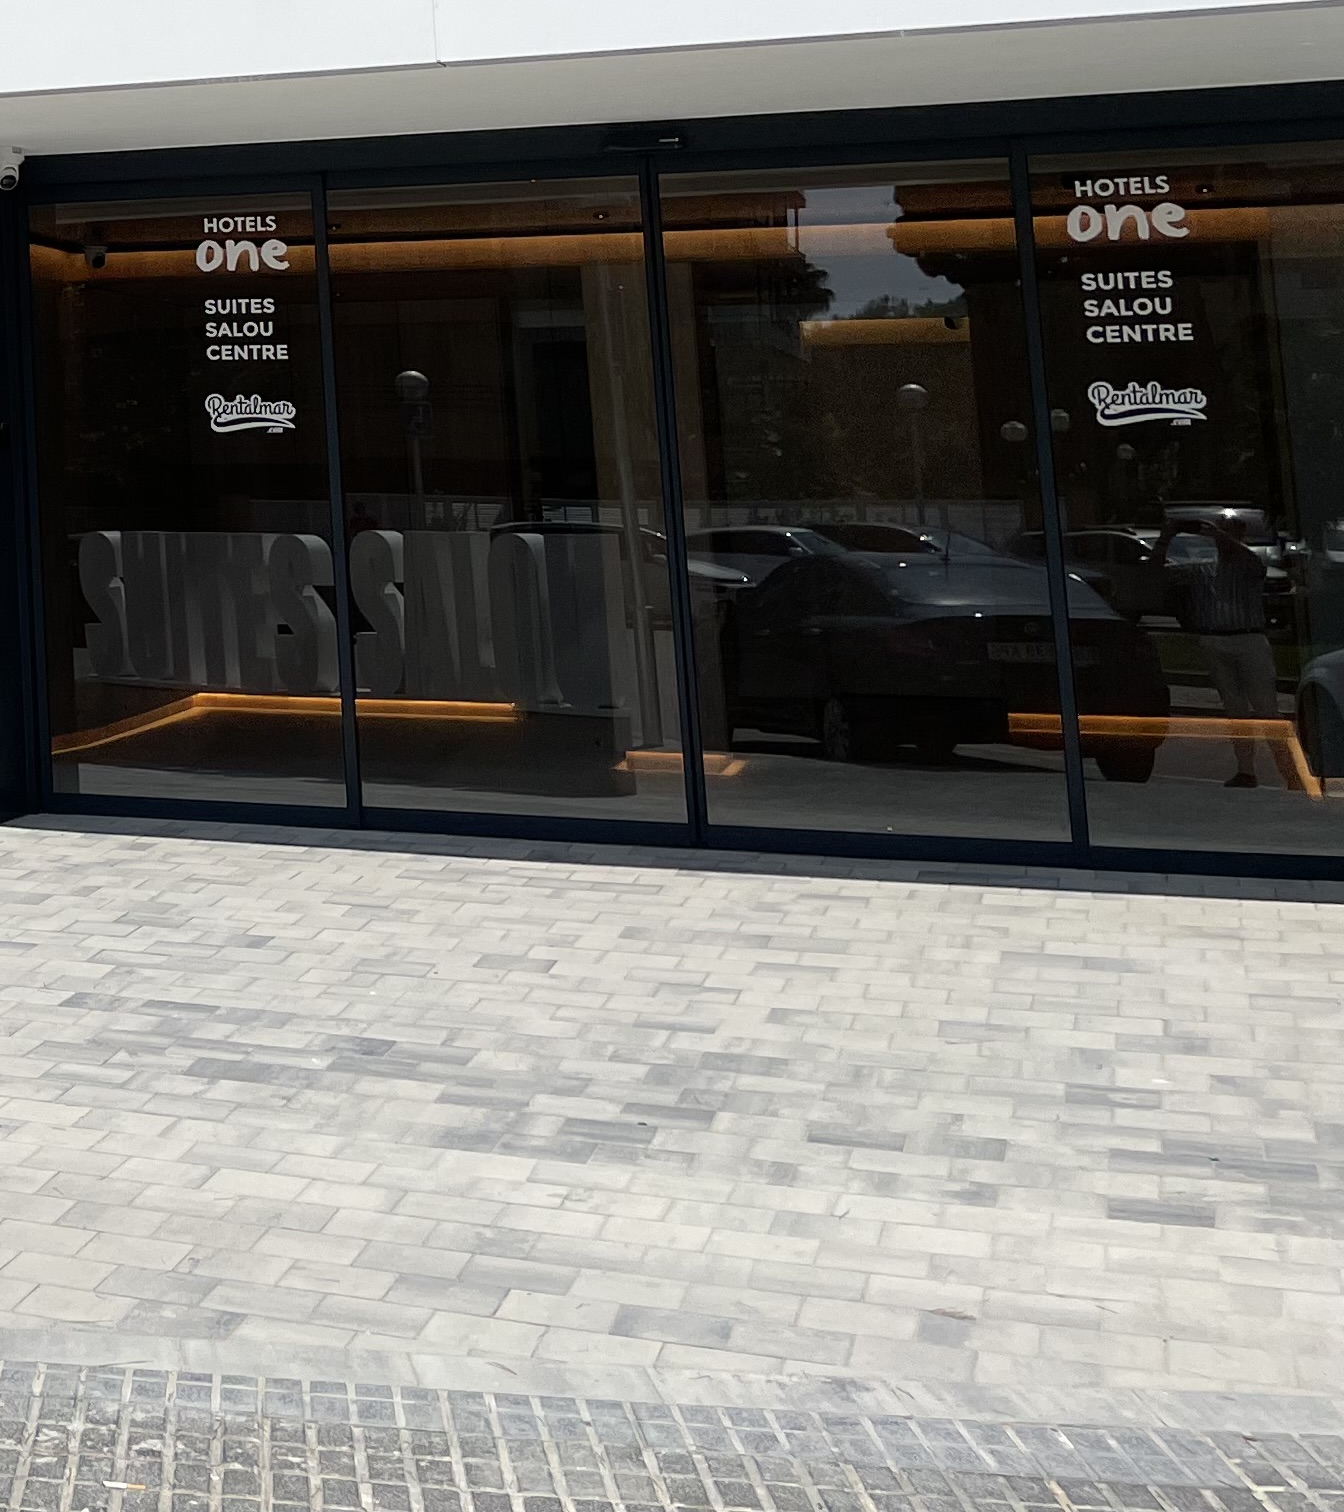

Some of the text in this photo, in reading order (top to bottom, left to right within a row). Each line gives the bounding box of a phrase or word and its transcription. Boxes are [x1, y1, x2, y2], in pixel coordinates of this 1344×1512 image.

[1074, 175, 1171, 198] HOTELS
[203, 215, 277, 233] HOTELS
[1066, 202, 1190, 242] one
[196, 238, 291, 272] one
[1081, 270, 1174, 291] SUITES
[204, 298, 275, 315] SUITES
[1083, 297, 1173, 317] SALOU
[205, 321, 273, 338] SALOU
[1086, 323, 1194, 343] CENTRE
[206, 344, 289, 361] CENTRE
[1088, 382, 1207, 410] Rentalmar
[205, 394, 296, 420] Rentalmar
